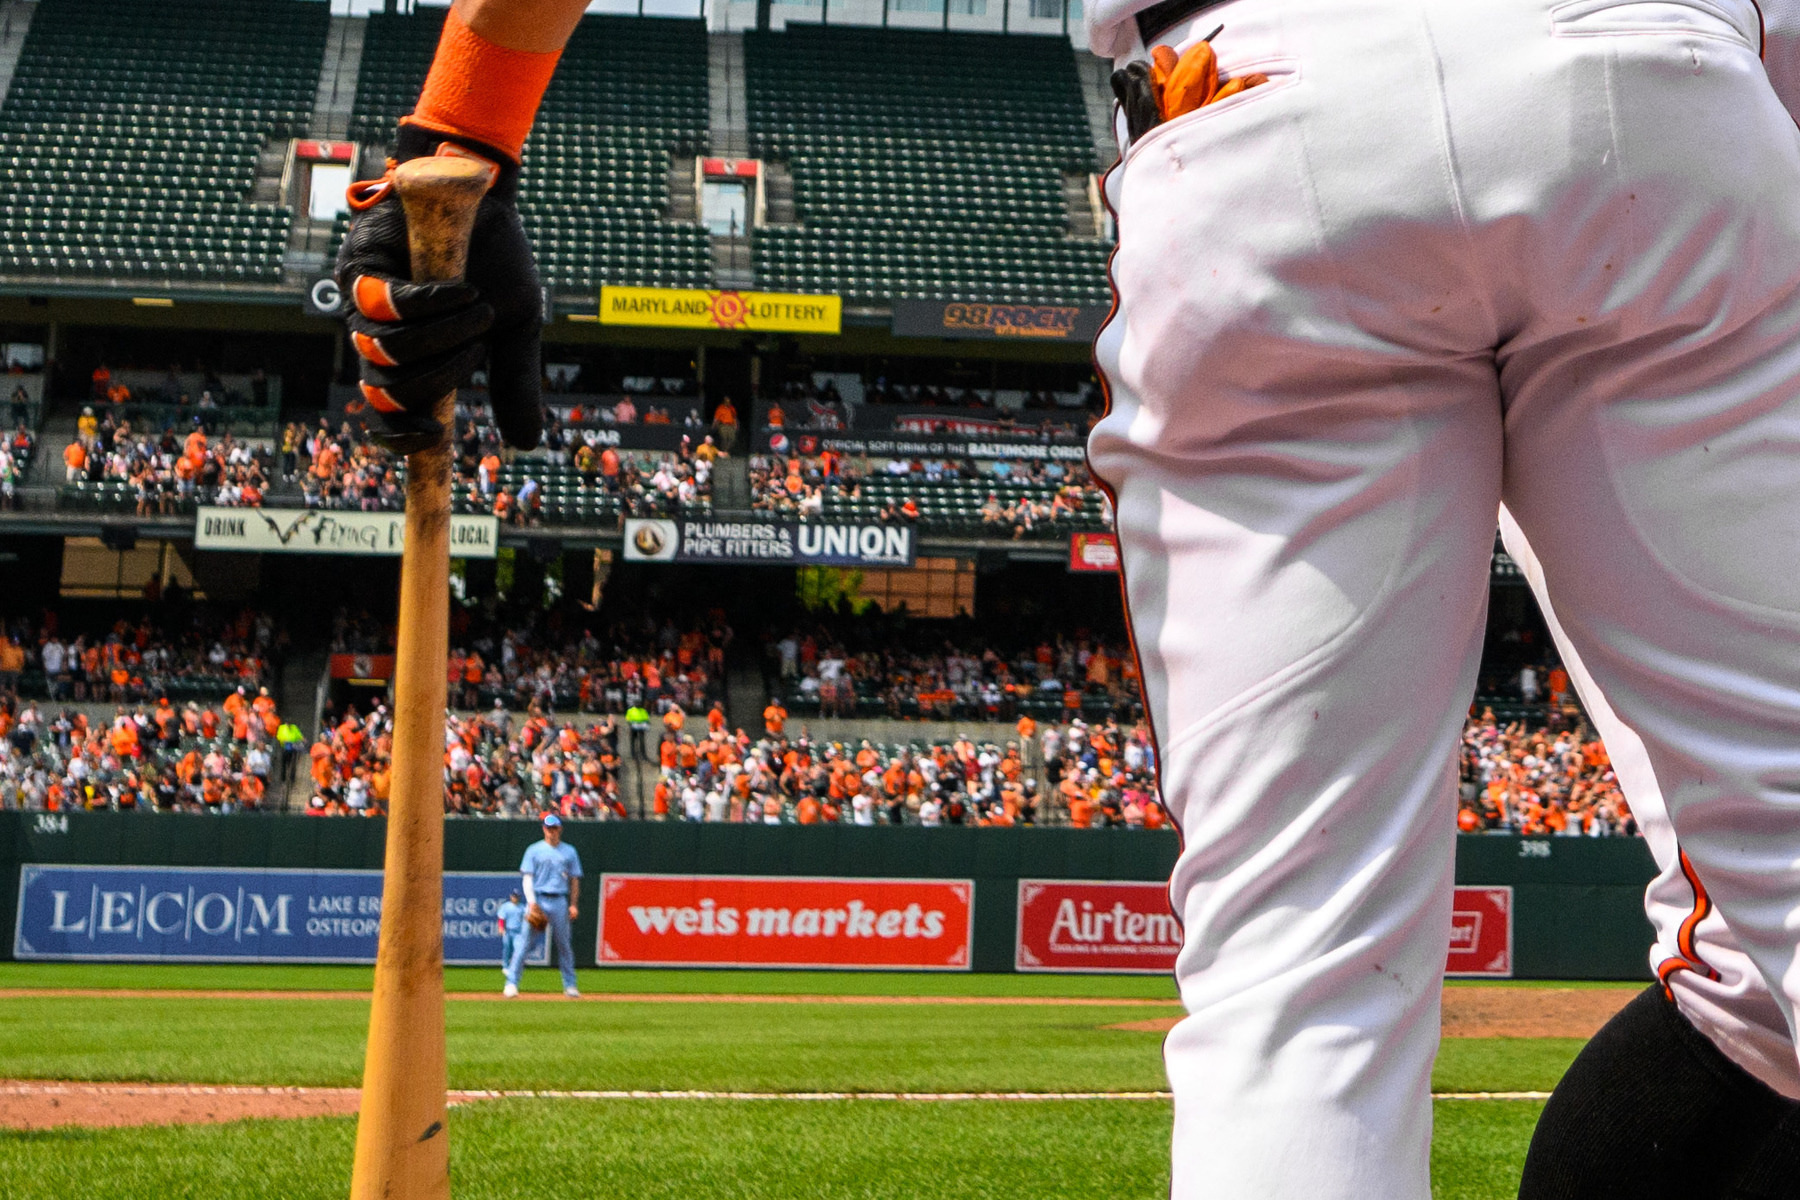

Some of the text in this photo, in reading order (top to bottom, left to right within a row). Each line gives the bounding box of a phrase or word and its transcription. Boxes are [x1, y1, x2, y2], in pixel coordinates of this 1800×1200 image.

[611, 296, 708, 316] MARYLAND
[750, 302, 827, 321] LOTTERY
[968, 442, 1048, 460] BALTIMORE
[204, 515, 246, 537] DRINK
[684, 521, 791, 541] PLUMBERS &
[684, 539, 794, 559] PIPE FITTERS
[798, 523, 910, 558] UNION
[308, 895, 354, 915] LAKE
[628, 897, 946, 939] weis markets
